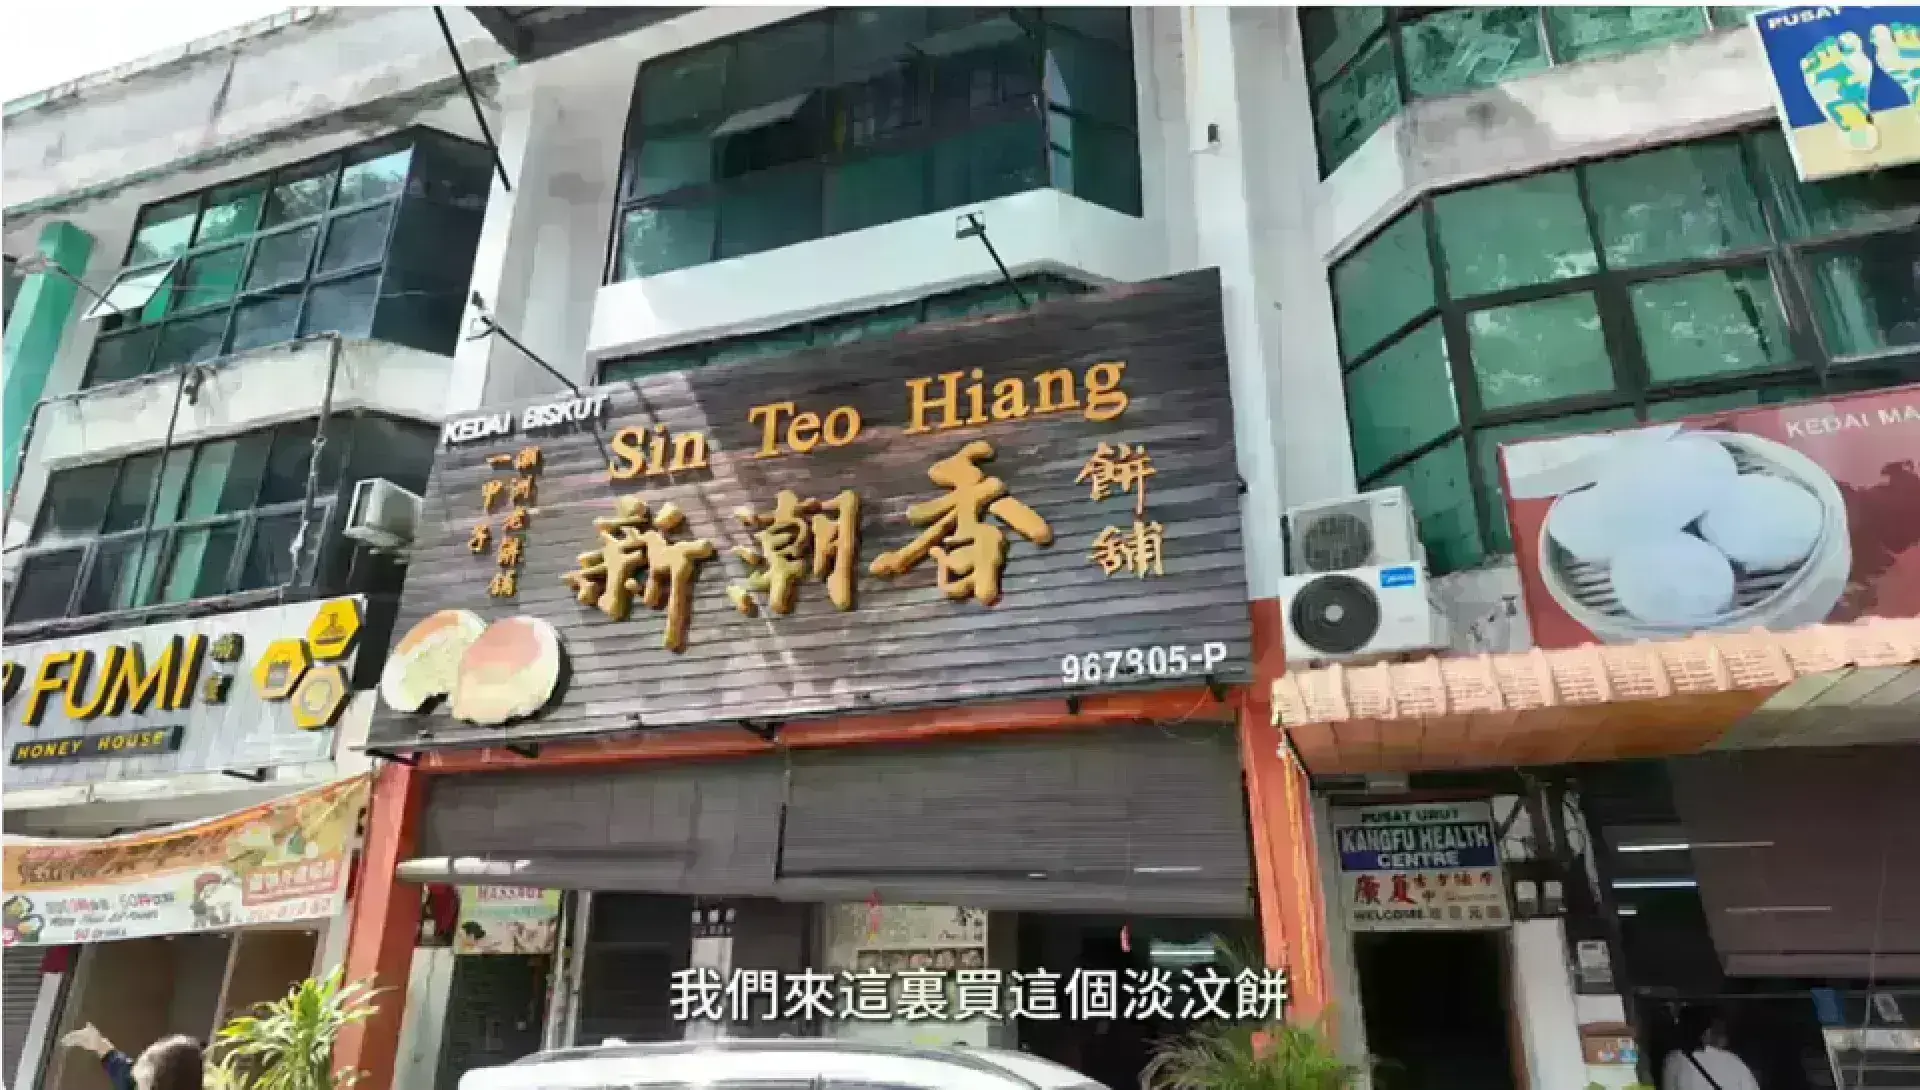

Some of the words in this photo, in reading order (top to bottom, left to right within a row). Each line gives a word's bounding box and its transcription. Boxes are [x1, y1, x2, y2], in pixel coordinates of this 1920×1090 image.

[442, 411, 512, 443] KEDAI
[522, 394, 609, 429] BISKUT
[609, 425, 707, 479] Sin
[748, 401, 862, 459] Teo
[904, 360, 1130, 435] Hiang
[1785, 412, 1869, 439] KEDAI
[557, 440, 1055, 652] 新潮香
[22, 633, 207, 726] FUMI
[17, 740, 82, 760] HONEY
[97, 730, 164, 751] HOUSE
[1341, 827, 1415, 853] KANGFU
[1419, 824, 1489, 851] HEALTH
[1377, 850, 1460, 868] CENTRE
